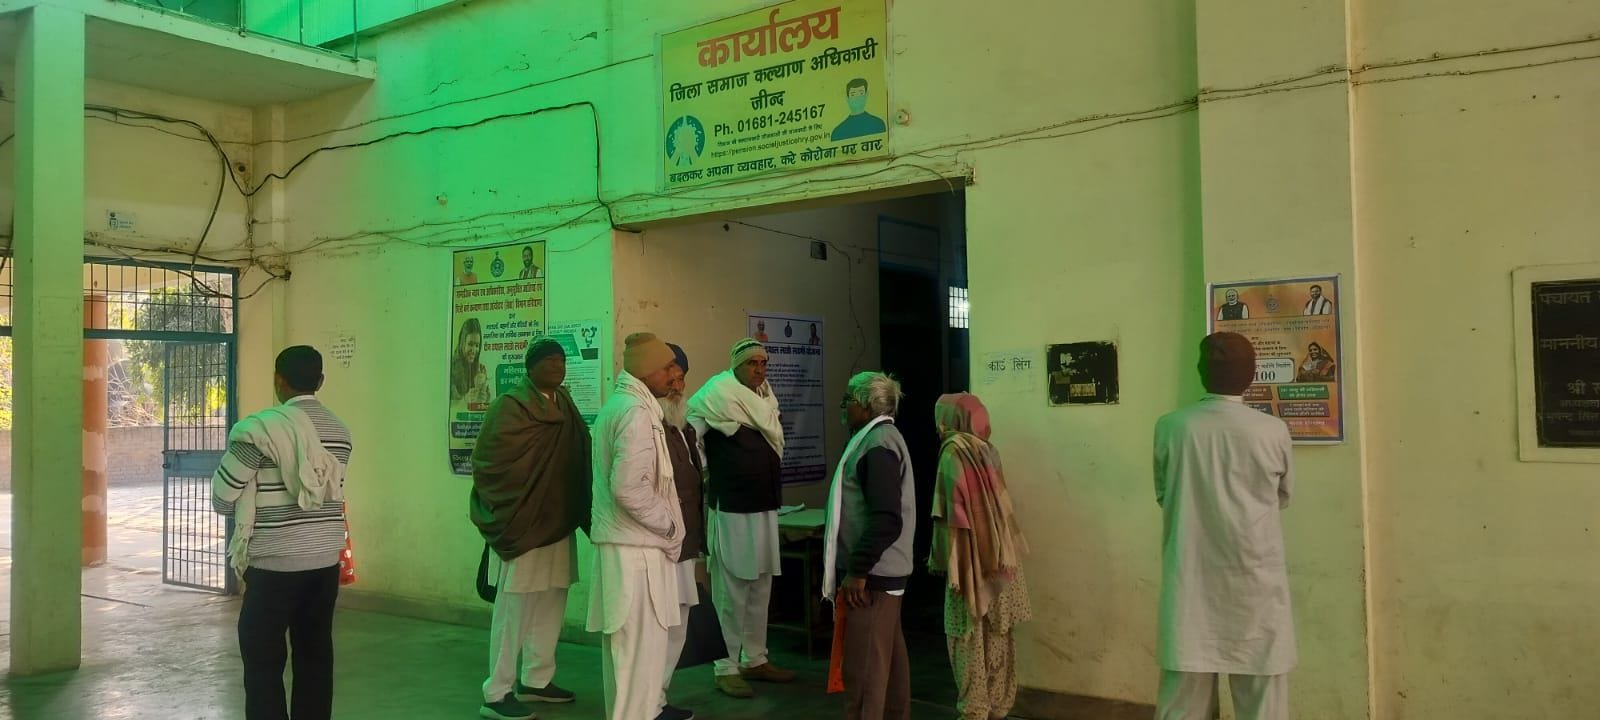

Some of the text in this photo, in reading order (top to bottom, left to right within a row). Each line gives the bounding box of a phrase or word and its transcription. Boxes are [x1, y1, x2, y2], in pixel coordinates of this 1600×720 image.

[697, 6, 842, 68] कार्यालय
[670, 37, 879, 103] जिला समाज कल्याण अधिकारी
[714, 104, 826, 137] Ph. 01681-245167
[749, 89, 786, 111] जीन्द
[668, 169, 704, 183] बदलकर
[705, 164, 734, 178] अपना
[800, 147, 837, 162] कोरोना
[841, 142, 857, 156] पर
[861, 138, 883, 151] वार
